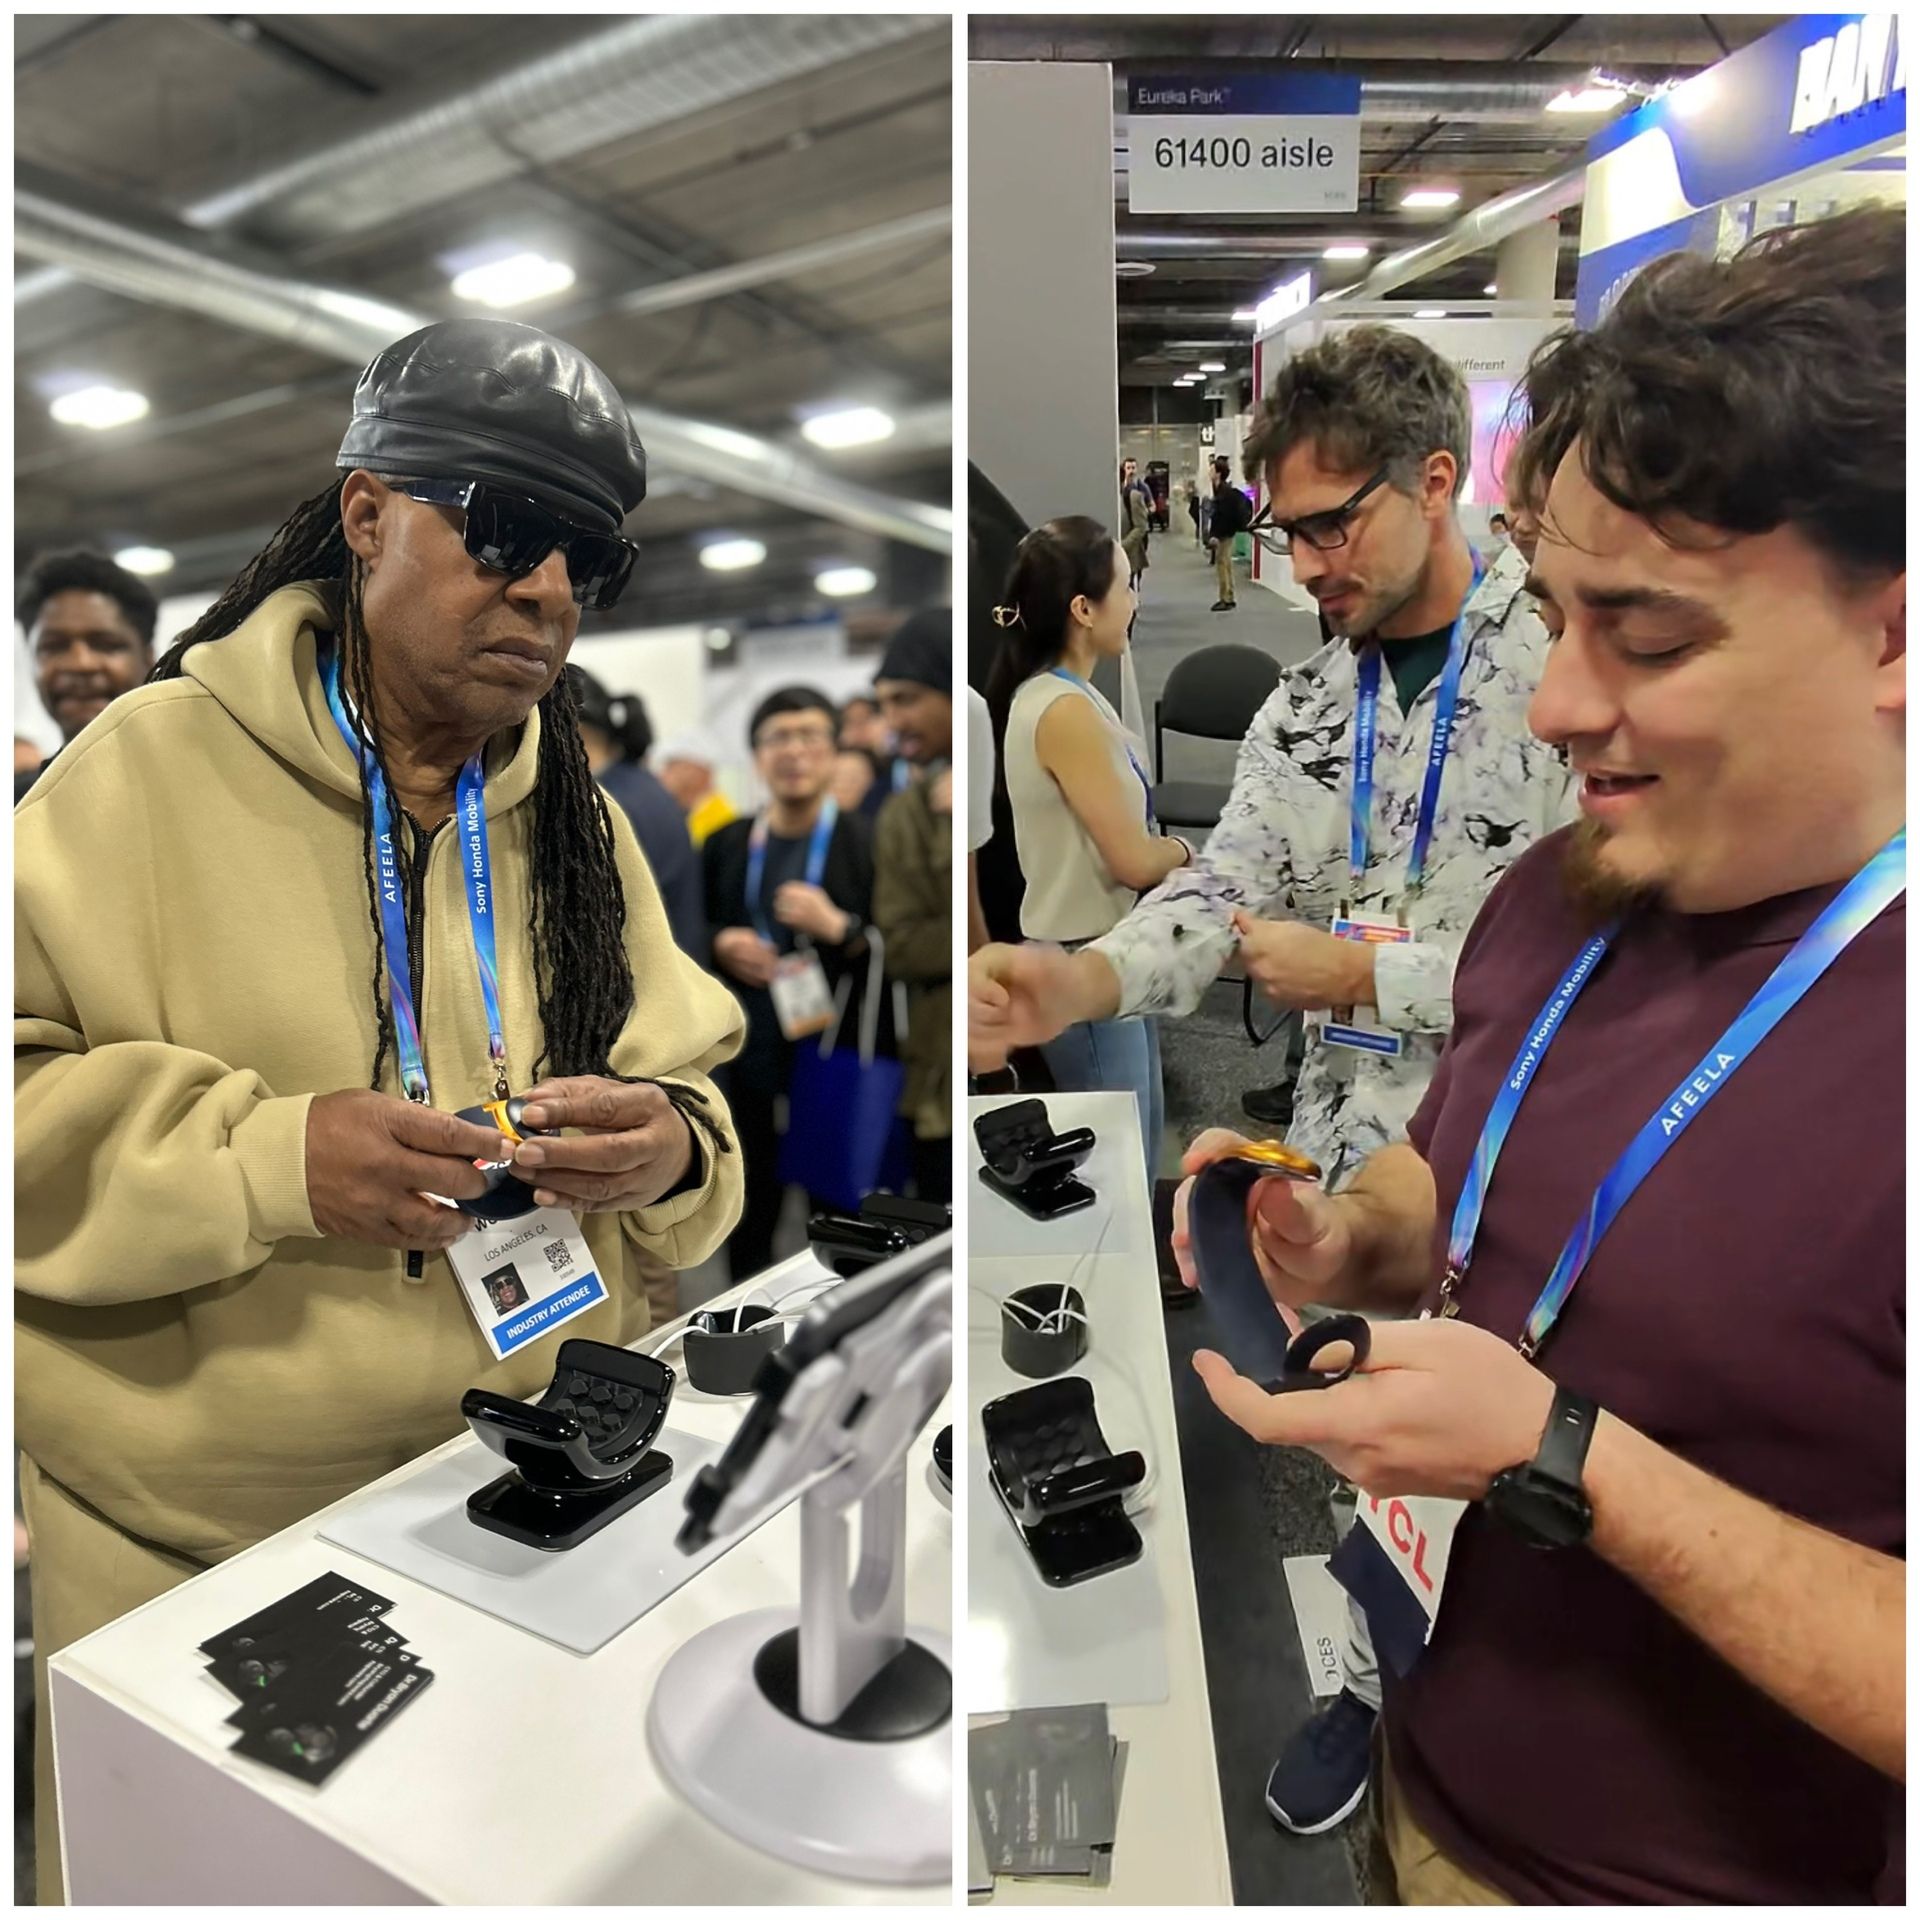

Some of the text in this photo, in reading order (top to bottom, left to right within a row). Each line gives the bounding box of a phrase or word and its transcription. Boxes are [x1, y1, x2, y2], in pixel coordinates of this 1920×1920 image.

[1138, 87, 1187, 105] Eureka
[1155, 137, 1334, 168] 61400 aisle
[380, 833, 396, 903] AFEELA
[464, 788, 487, 914] Sony Honda Mobility
[1510, 937, 1605, 1090] Sony Honda Mobility
[1660, 1051, 1735, 1136] AFEELA
[484, 1247, 501, 1262] LOS
[535, 1223, 548, 1235] CA
[506, 1284, 592, 1340] INDUSTRY ATTENDEE
